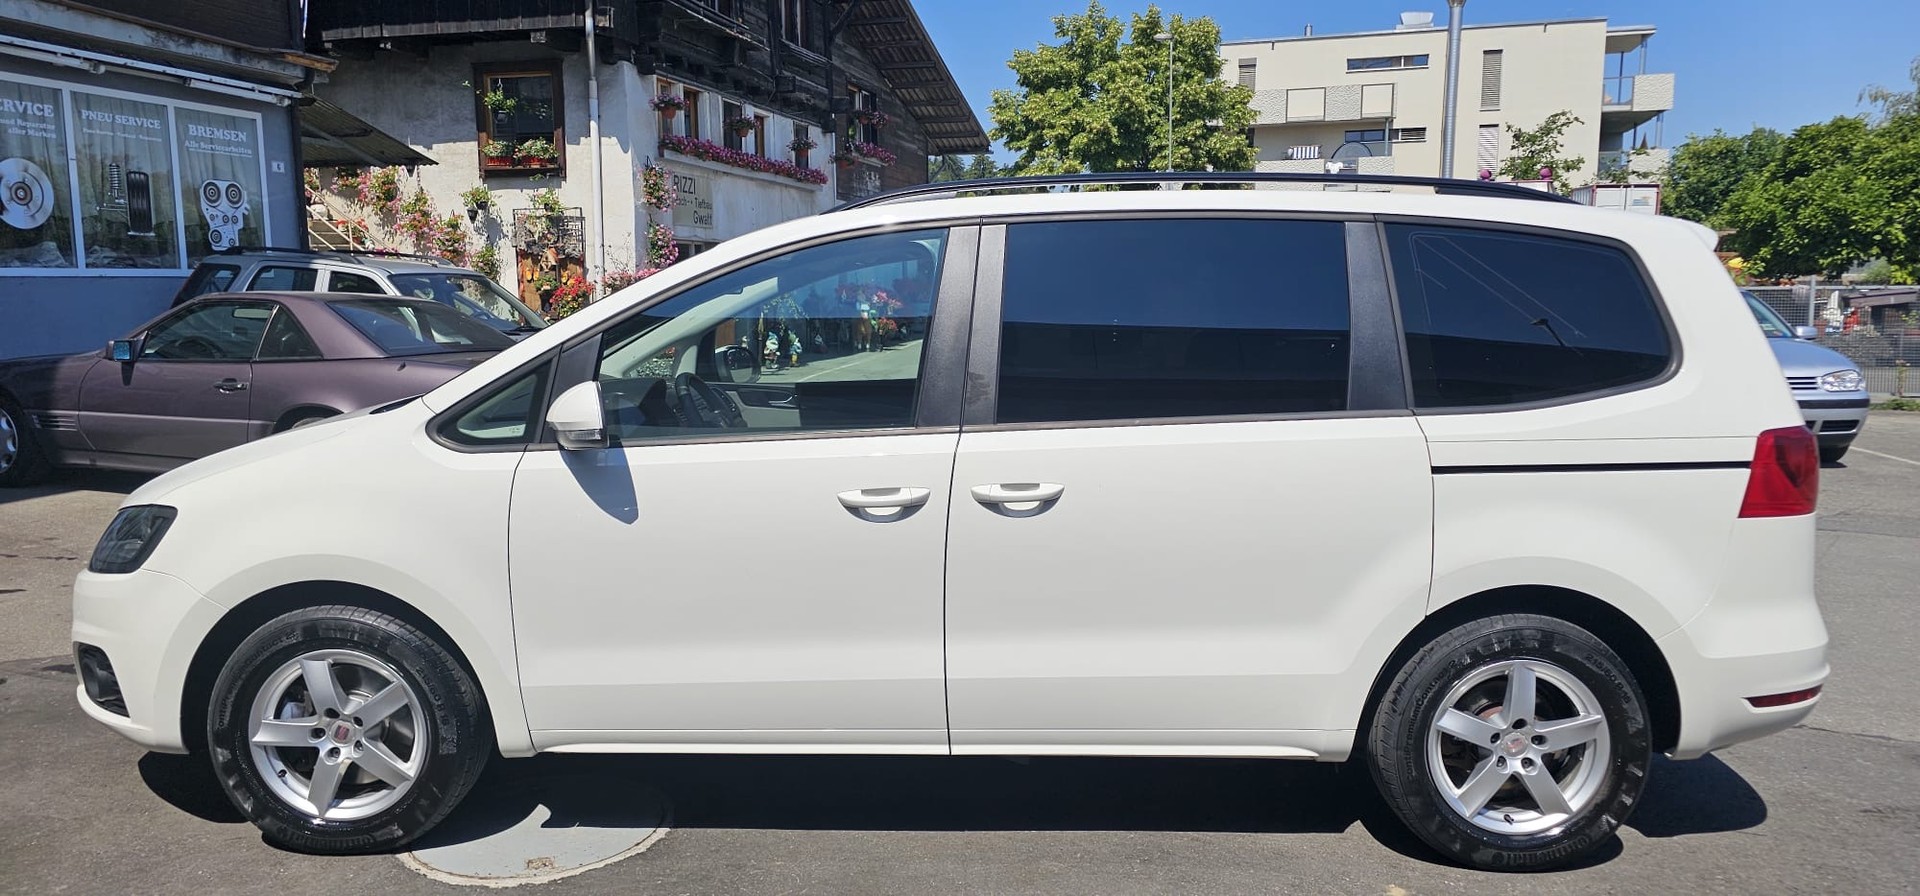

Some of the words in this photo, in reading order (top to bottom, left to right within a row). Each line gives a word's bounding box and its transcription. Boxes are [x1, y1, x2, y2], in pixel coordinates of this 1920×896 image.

[81, 109, 113, 122] PNEU
[115, 114, 161, 129] SERVICE
[187, 124, 247, 142] BREMSEN
[184, 139, 199, 148] Alle
[200, 141, 252, 155] Servicearbeiten
[673, 174, 696, 195] RIZZI
[694, 197, 713, 210] Tiefbau
[693, 210, 713, 226] Gwatt
